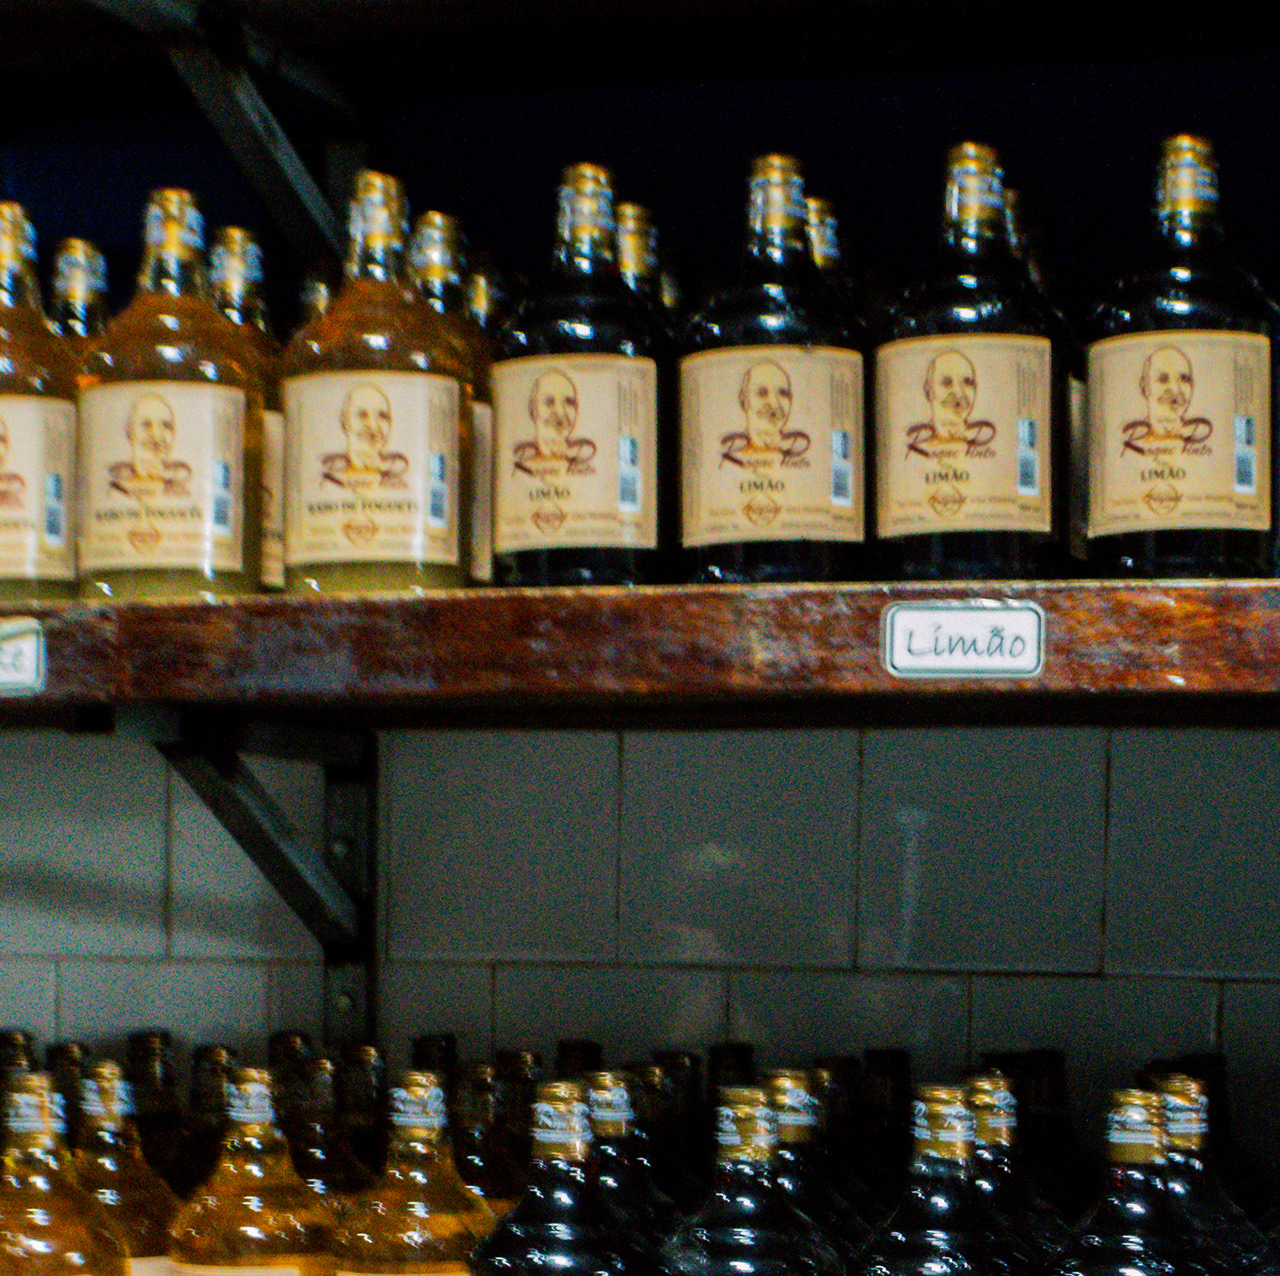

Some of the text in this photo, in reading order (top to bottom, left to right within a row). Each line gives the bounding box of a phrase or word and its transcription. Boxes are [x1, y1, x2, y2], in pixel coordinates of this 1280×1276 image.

[925, 469, 970, 485] LIMÃO
[1140, 467, 1186, 482] LIMÃO
[907, 623, 1027, 658] Limão
